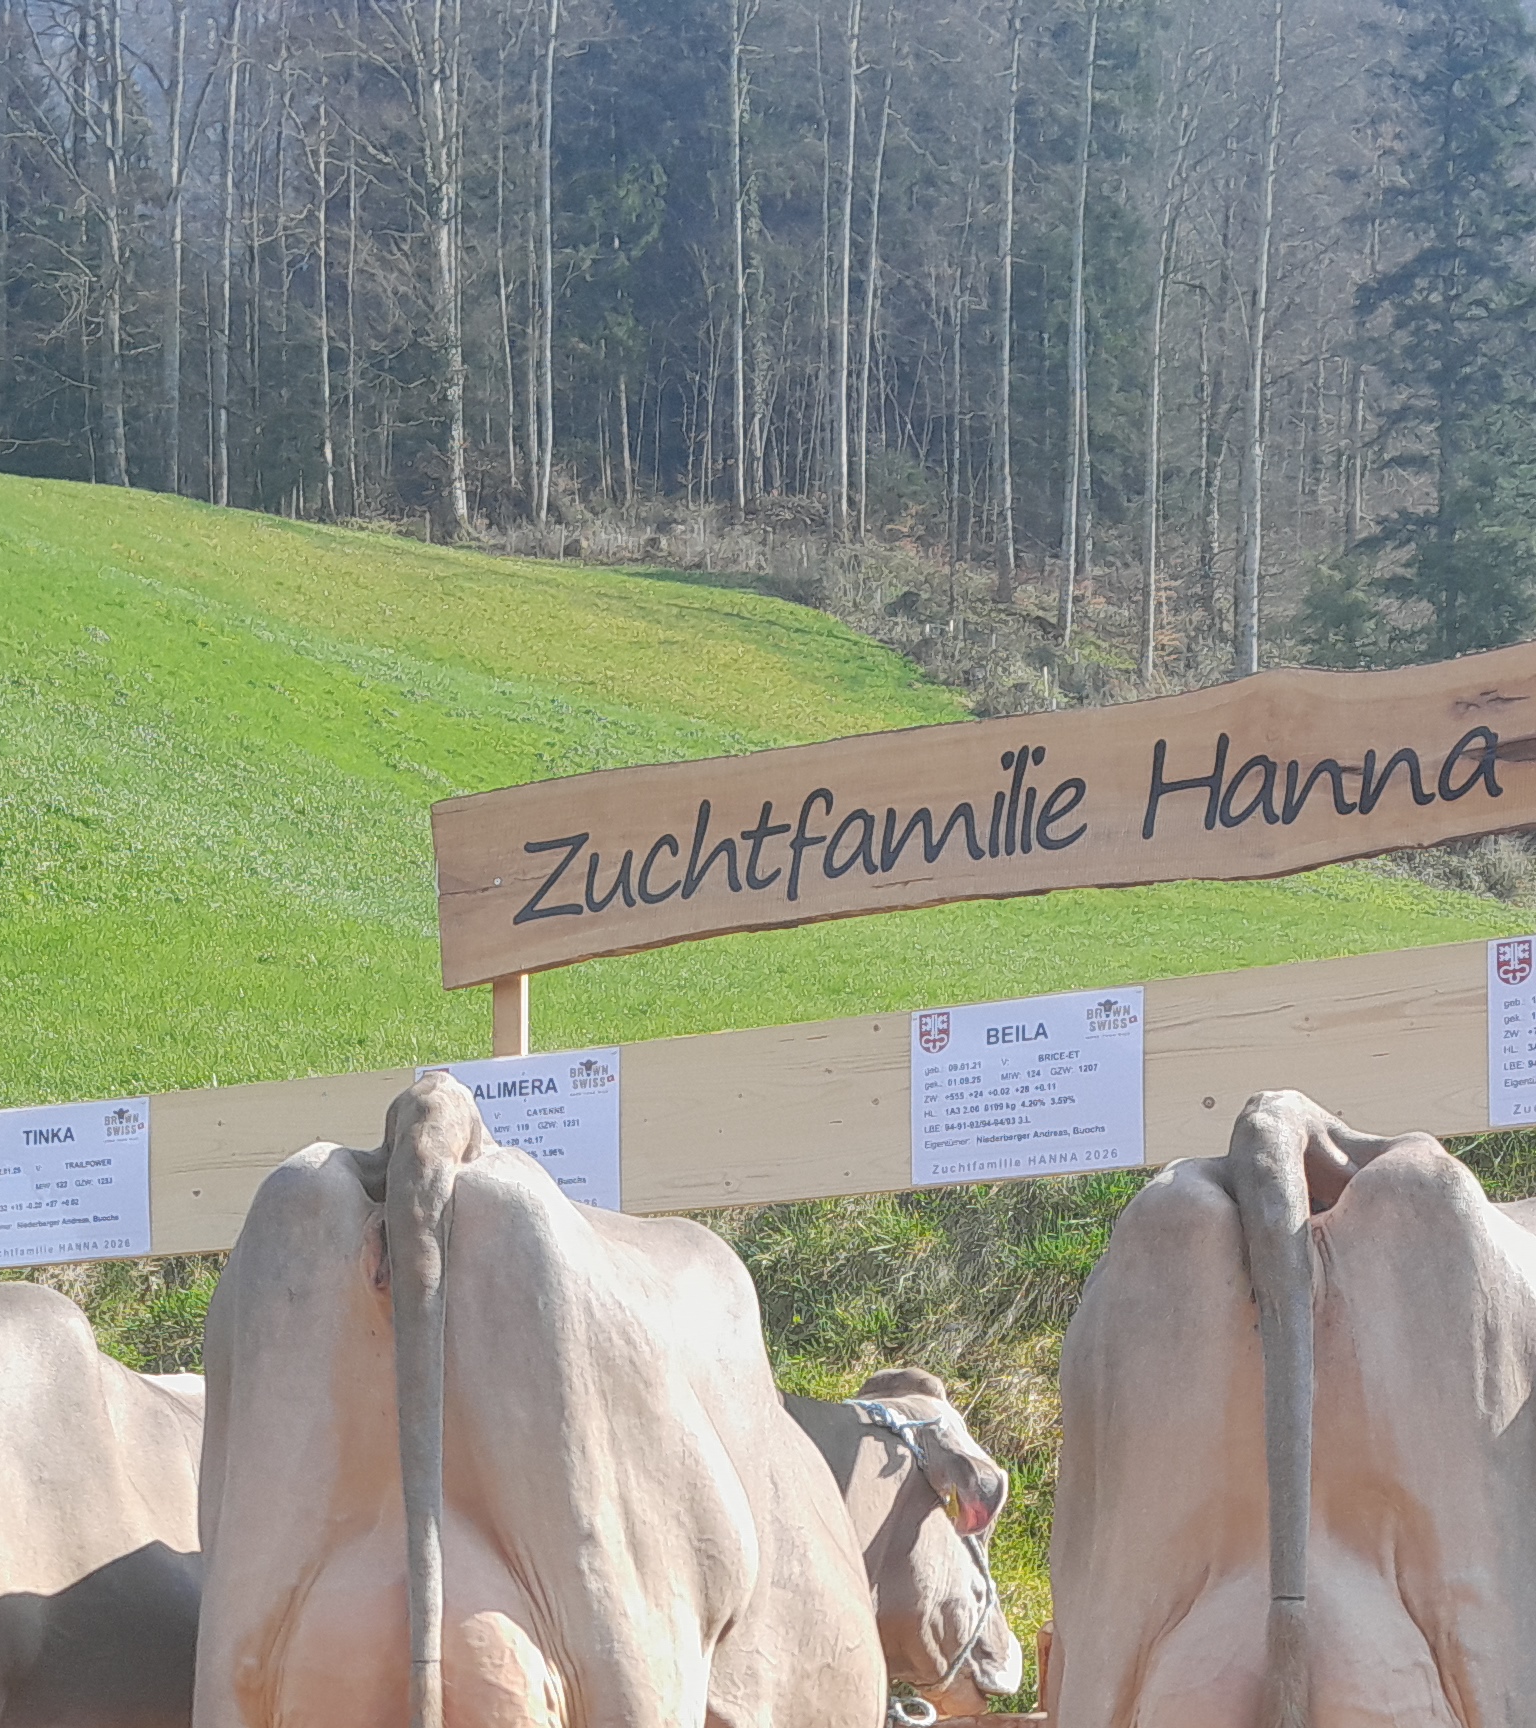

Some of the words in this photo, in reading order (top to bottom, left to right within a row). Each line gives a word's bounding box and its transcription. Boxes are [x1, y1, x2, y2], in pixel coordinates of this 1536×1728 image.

[512, 744, 1089, 927] Zuchtfamilie
[1142, 725, 1502, 839] Hanna
[1089, 1017, 1127, 1032] SWISS
[986, 1023, 1048, 1046] BEILA
[1038, 1050, 1080, 1062] BRICE-ET
[1079, 1064, 1098, 1073] 1207
[572, 1077, 605, 1089] SWISS
[1006, 1102, 1016, 1111] kg
[23, 1127, 75, 1145] TINKA
[106, 1124, 136, 1137] SWISS
[932, 1158, 1020, 1174] Zuchtfamilie
[1029, 1152, 1078, 1166] HANNA
[1085, 1148, 1118, 1160] 2026
[59, 1241, 98, 1253] HANNA
